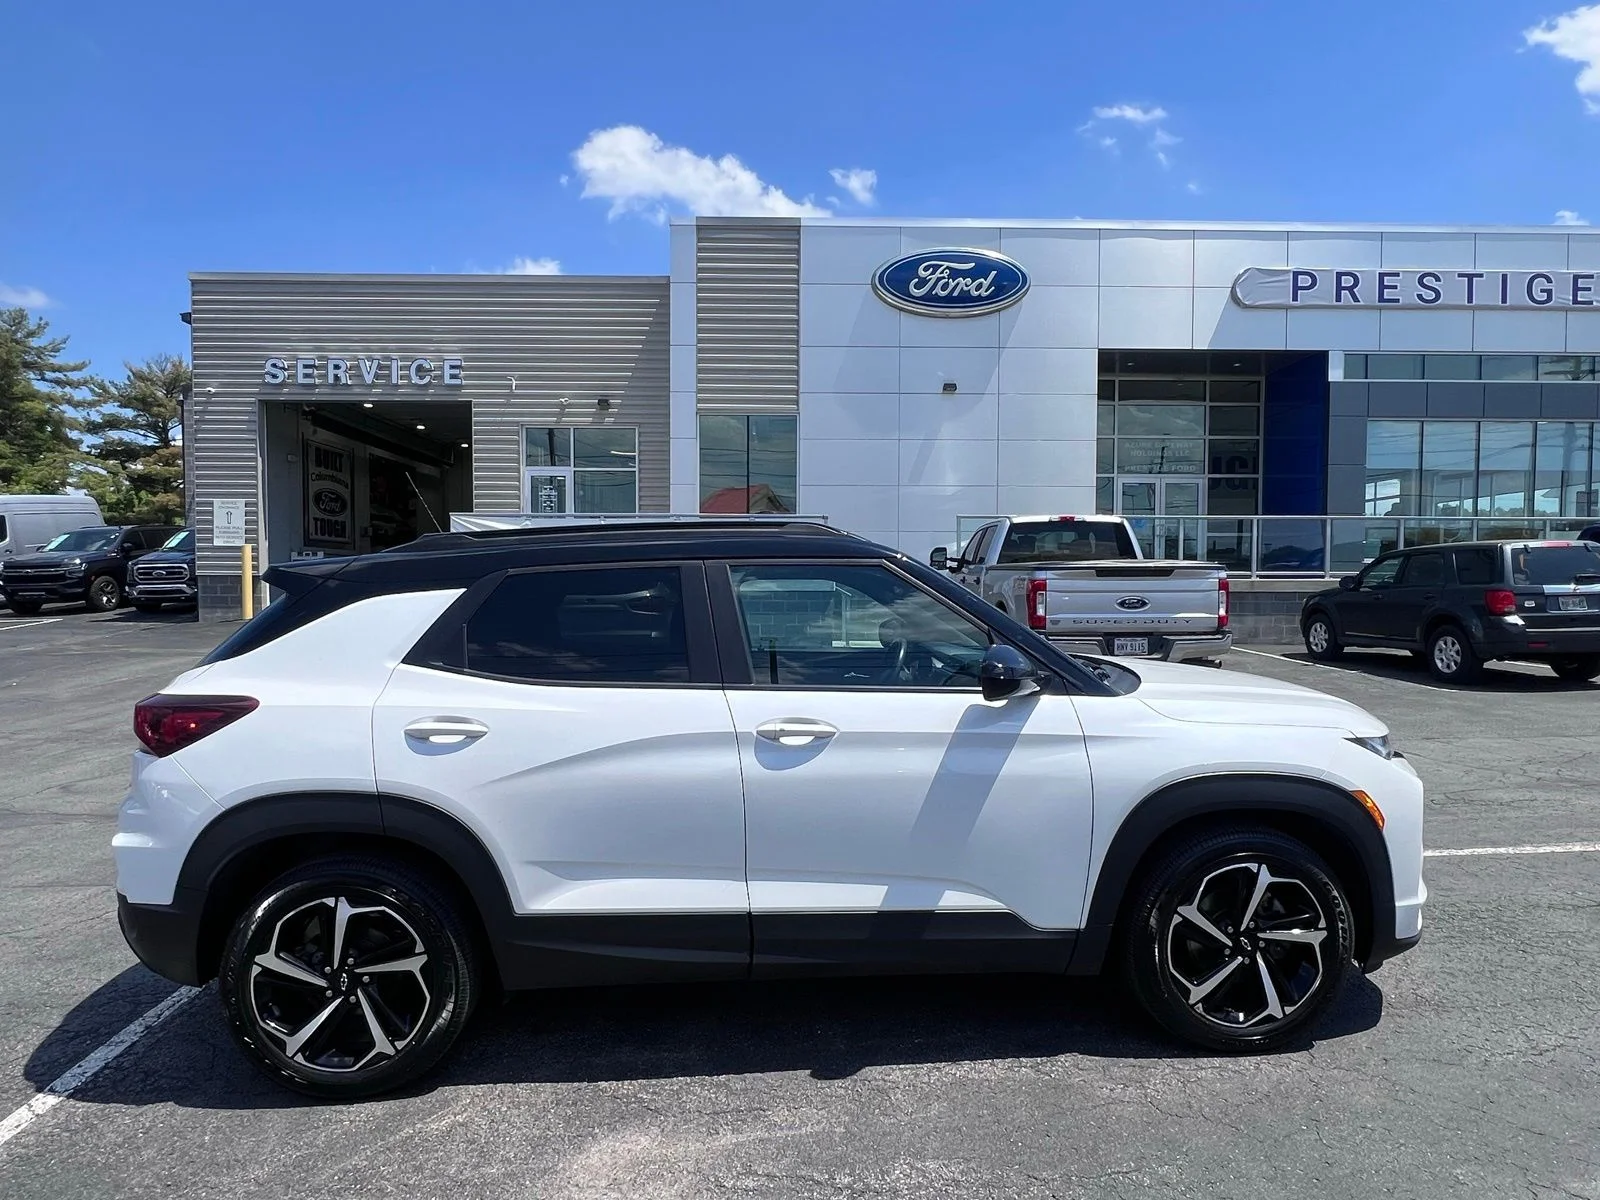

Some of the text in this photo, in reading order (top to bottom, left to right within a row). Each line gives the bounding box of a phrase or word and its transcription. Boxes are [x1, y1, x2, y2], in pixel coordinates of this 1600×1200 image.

[909, 260, 997, 297] Ford
[1290, 270, 1596, 306] PRESTIGE
[264, 358, 464, 386] SERVICE
[315, 447, 344, 472] BUILT
[313, 516, 347, 539] TOUGH
